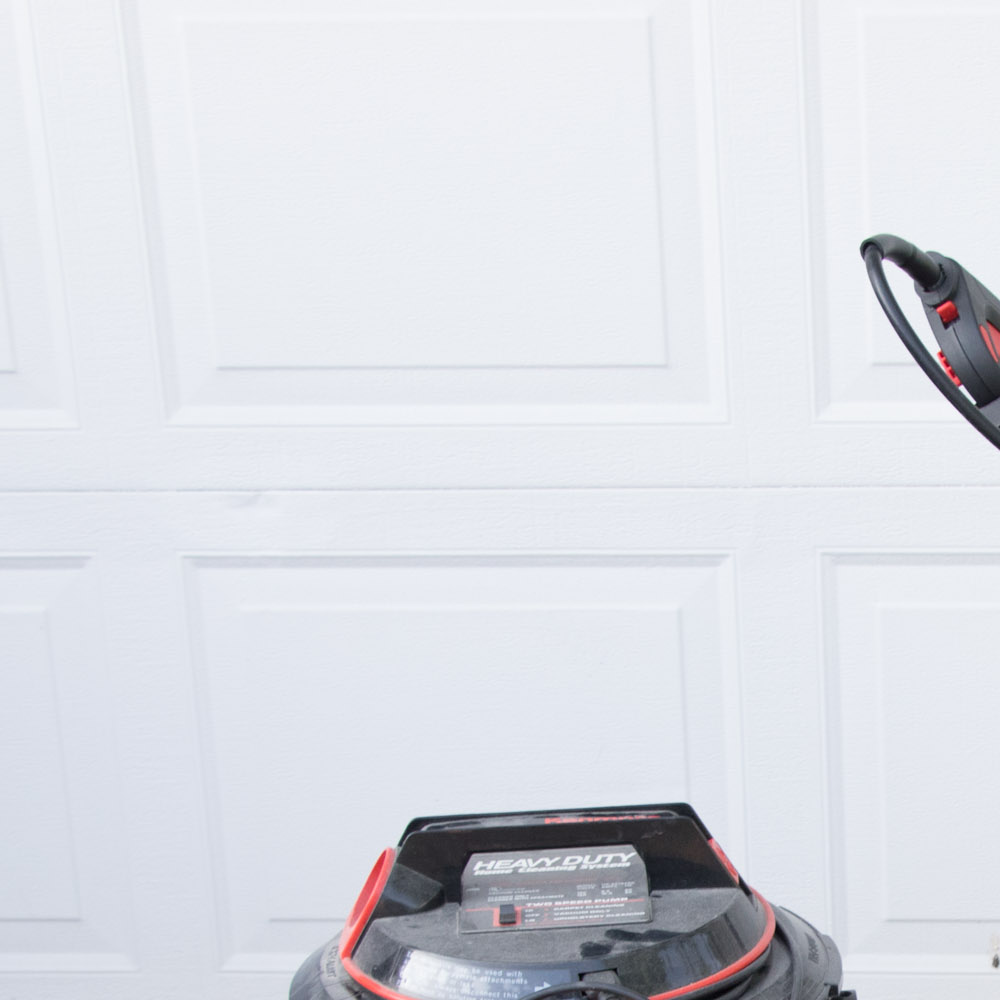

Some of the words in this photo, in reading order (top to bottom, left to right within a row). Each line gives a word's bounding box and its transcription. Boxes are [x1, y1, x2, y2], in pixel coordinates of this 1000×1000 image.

[473, 857, 560, 871] HEAVY
[562, 852, 636, 866] DUTY
[518, 865, 577, 873] Cleaning
[580, 862, 631, 870] System
[485, 969, 502, 977] used
[506, 970, 523, 978] with
[480, 976, 528, 985] attachments
[504, 991, 518, 999] this
